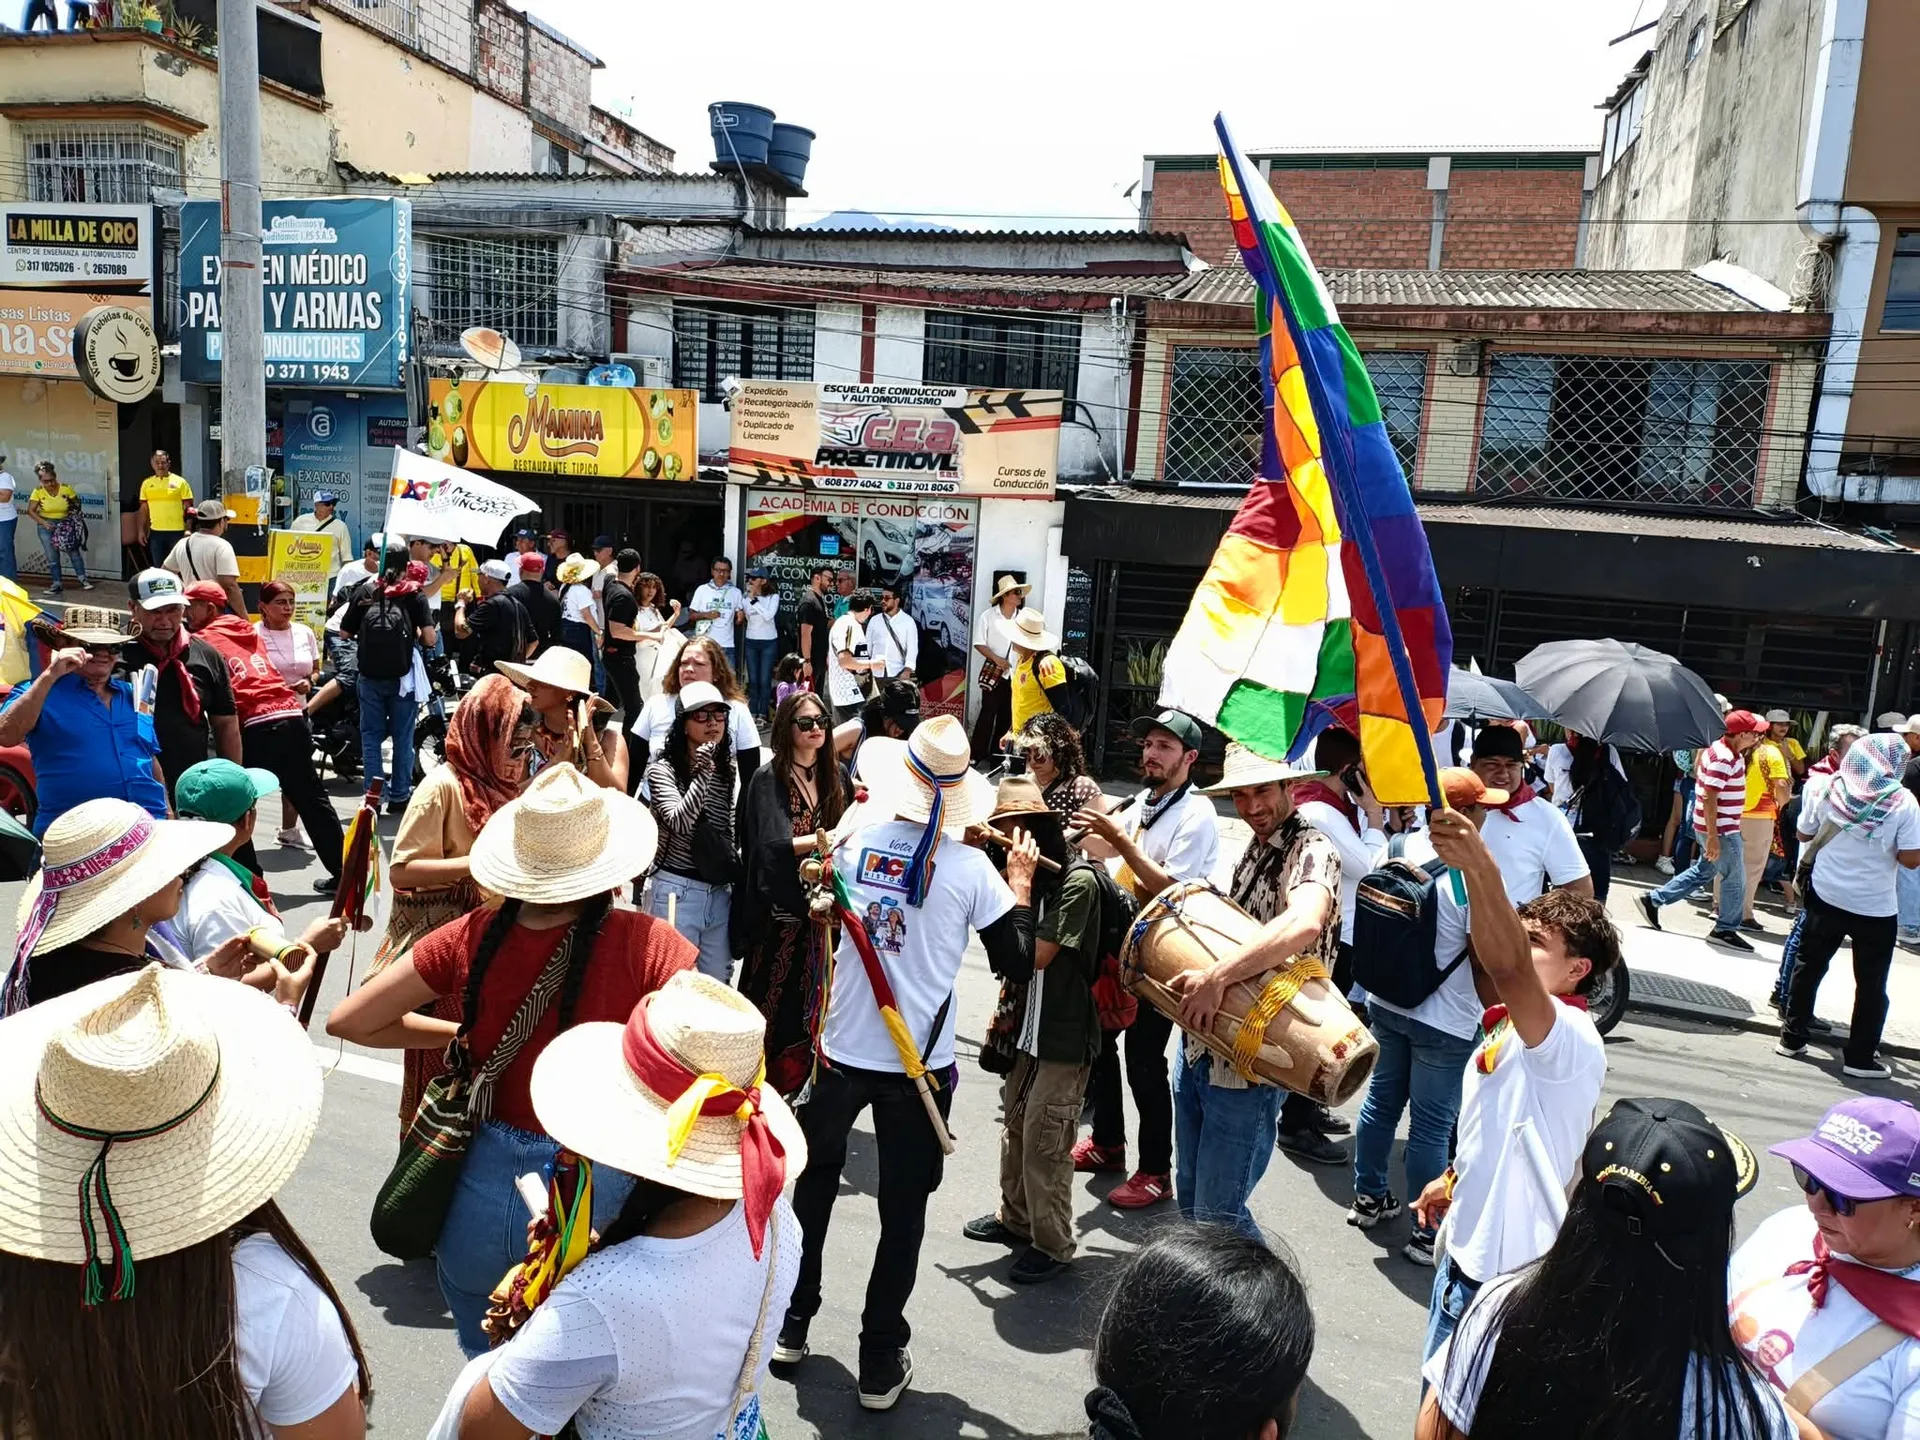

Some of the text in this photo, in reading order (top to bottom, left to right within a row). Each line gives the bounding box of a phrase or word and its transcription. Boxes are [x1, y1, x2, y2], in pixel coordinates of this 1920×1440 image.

[8, 218, 137, 245] LA MILLA DE ORO
[7, 247, 31, 255] CENTRO
[32, 248, 41, 256] DE
[27, 260, 40, 272] 317
[41, 261, 75, 273] 1025026
[92, 263, 128, 276] 2657089
[290, 249, 367, 286] MÉDICO
[0, 306, 71, 323] sas Listas
[122, 310, 134, 322] de
[189, 291, 383, 330] PA Y ARMAS
[264, 334, 362, 361] ONDUCTORES
[279, 364, 306, 379] 371
[313, 364, 350, 380] 1943
[744, 385, 788, 397] Expedición
[823, 384, 957, 398] ESCUELA DE CONDUCCION
[743, 397, 814, 410] Recategorización
[841, 393, 942, 406] Y AUTOMOVILISMO
[743, 408, 790, 420] Renovación
[743, 420, 795, 431] Duplicado de
[742, 431, 780, 442] Licencias
[300, 443, 338, 452] Certificamos
[513, 459, 599, 475] RESTAURANTE TIPICO
[997, 466, 1047, 478] Cursos de
[298, 469, 351, 486] EXAMEN
[824, 478, 883, 489] 608 277 4042
[993, 477, 1050, 490] Conducción
[896, 481, 911, 490] 318
[913, 482, 929, 491] 701
[759, 495, 969, 520] ACADEMIA DE CONDCCIÓN
[889, 839, 913, 853] Vota
[864, 872, 903, 884] HISTOR
